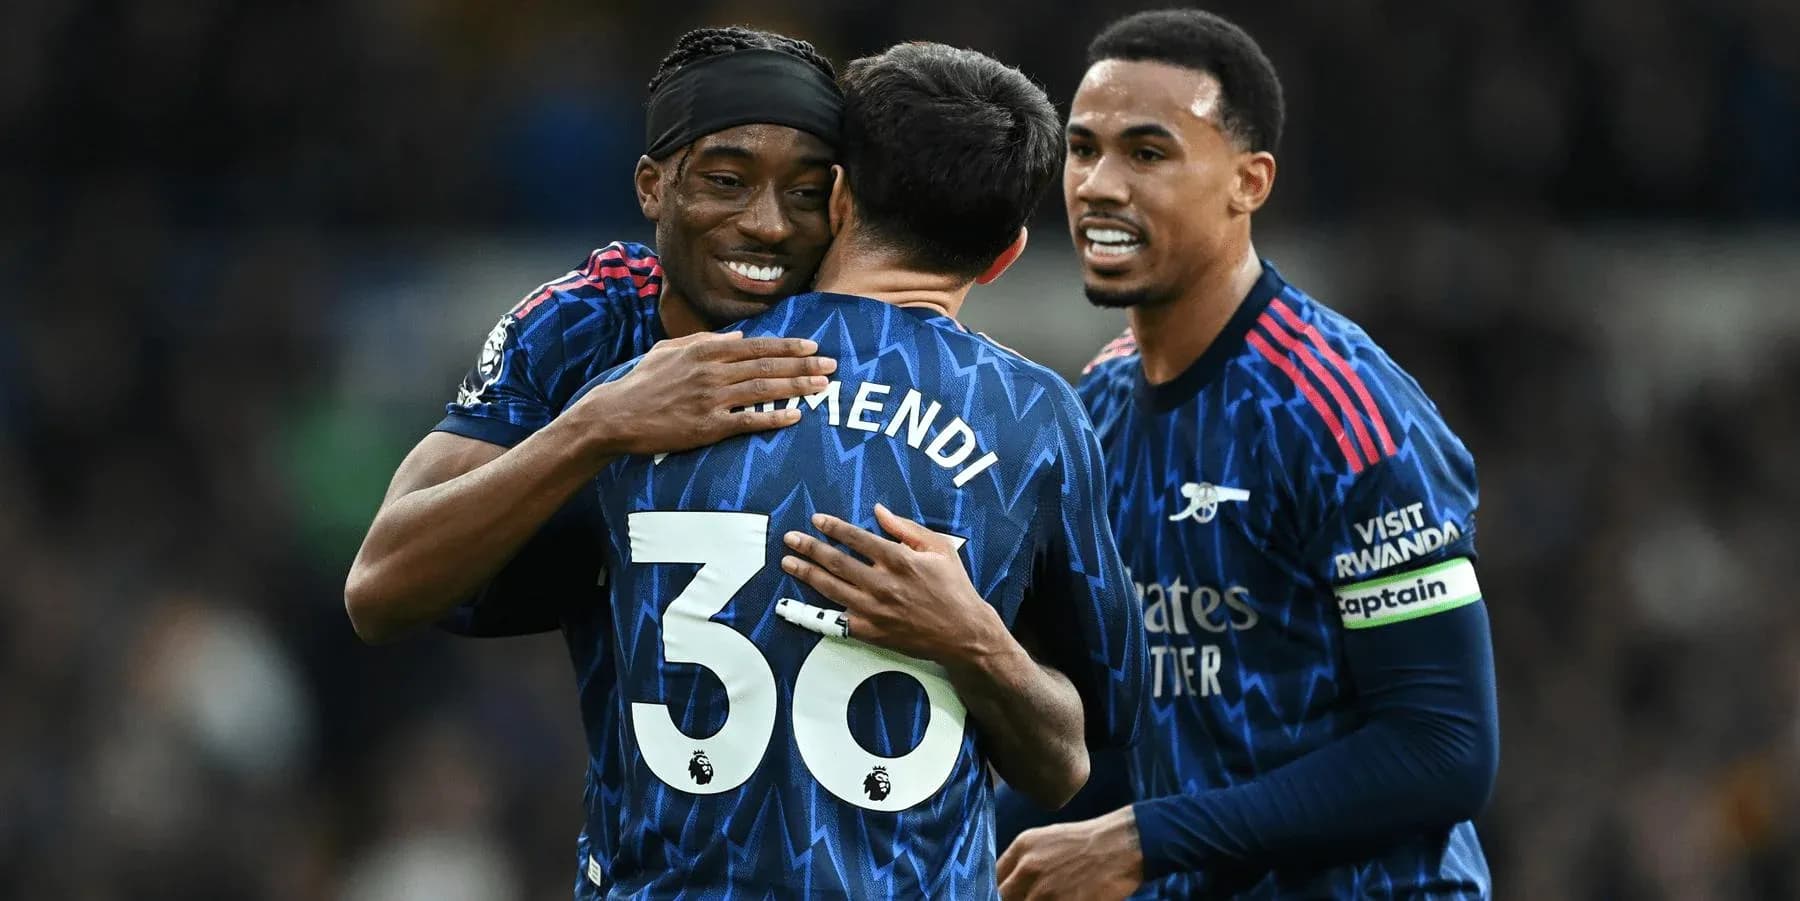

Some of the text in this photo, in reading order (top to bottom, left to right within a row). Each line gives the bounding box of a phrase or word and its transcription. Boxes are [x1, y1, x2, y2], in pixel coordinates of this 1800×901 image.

[653, 380, 998, 487] MENDI
[1335, 520, 1461, 579] RWANDA
[1354, 502, 1424, 544] VISIT
[627, 511, 967, 812] 36
[1151, 644, 1221, 697] TTER
